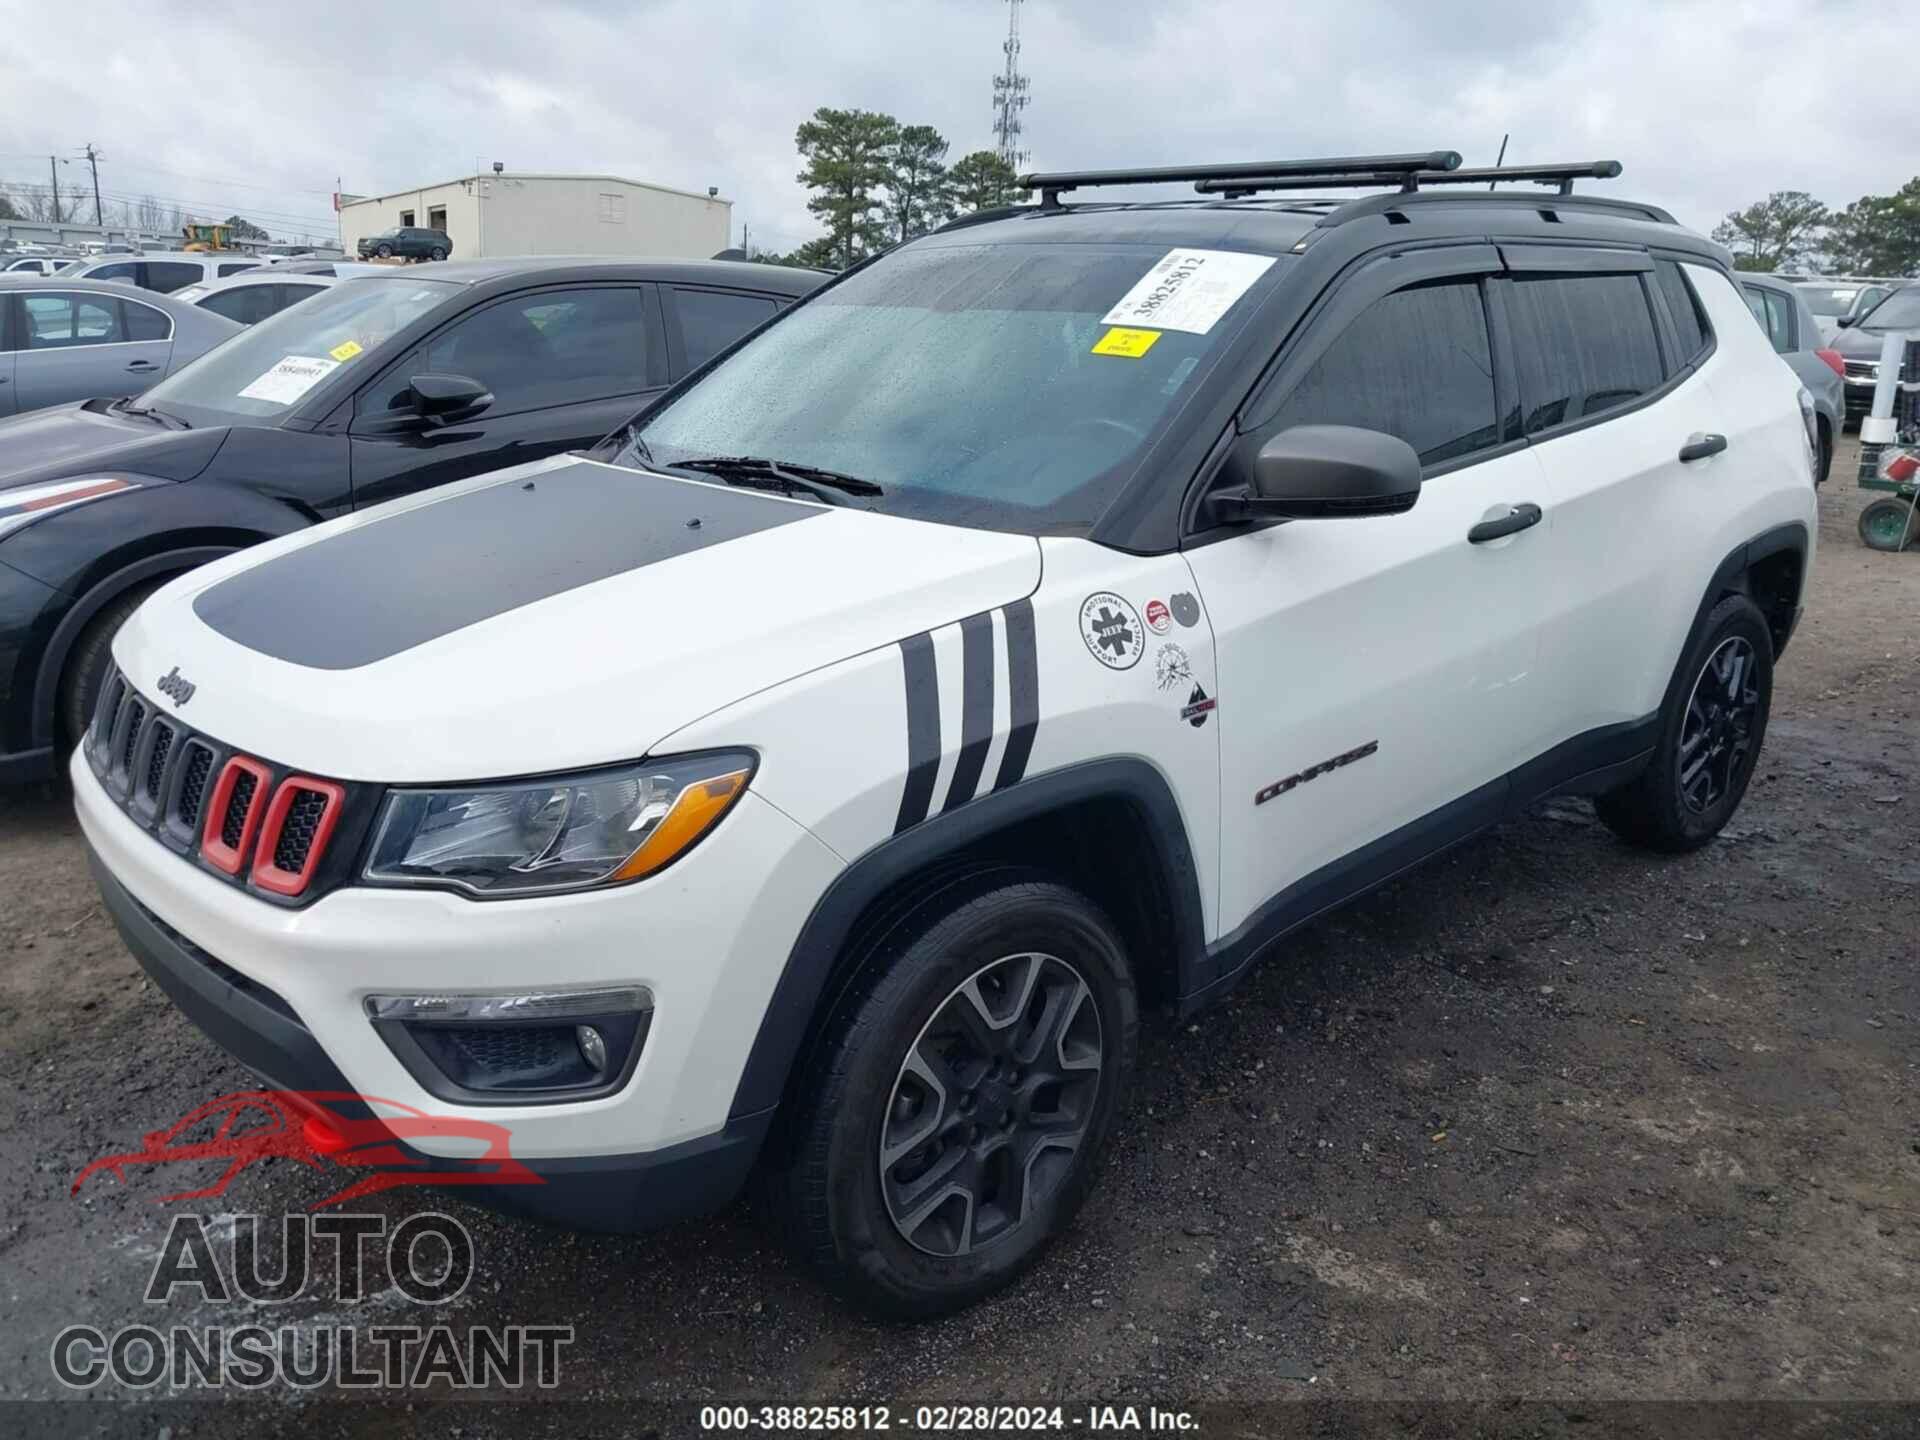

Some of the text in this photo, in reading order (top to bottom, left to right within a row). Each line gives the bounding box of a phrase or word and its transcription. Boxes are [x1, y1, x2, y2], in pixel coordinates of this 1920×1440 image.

[1133, 256, 1205, 318] 38825812
[1084, 596, 1123, 618] EMOTIONAL
[1101, 623, 1123, 638] JEEP
[157, 666, 196, 708] Jeep
